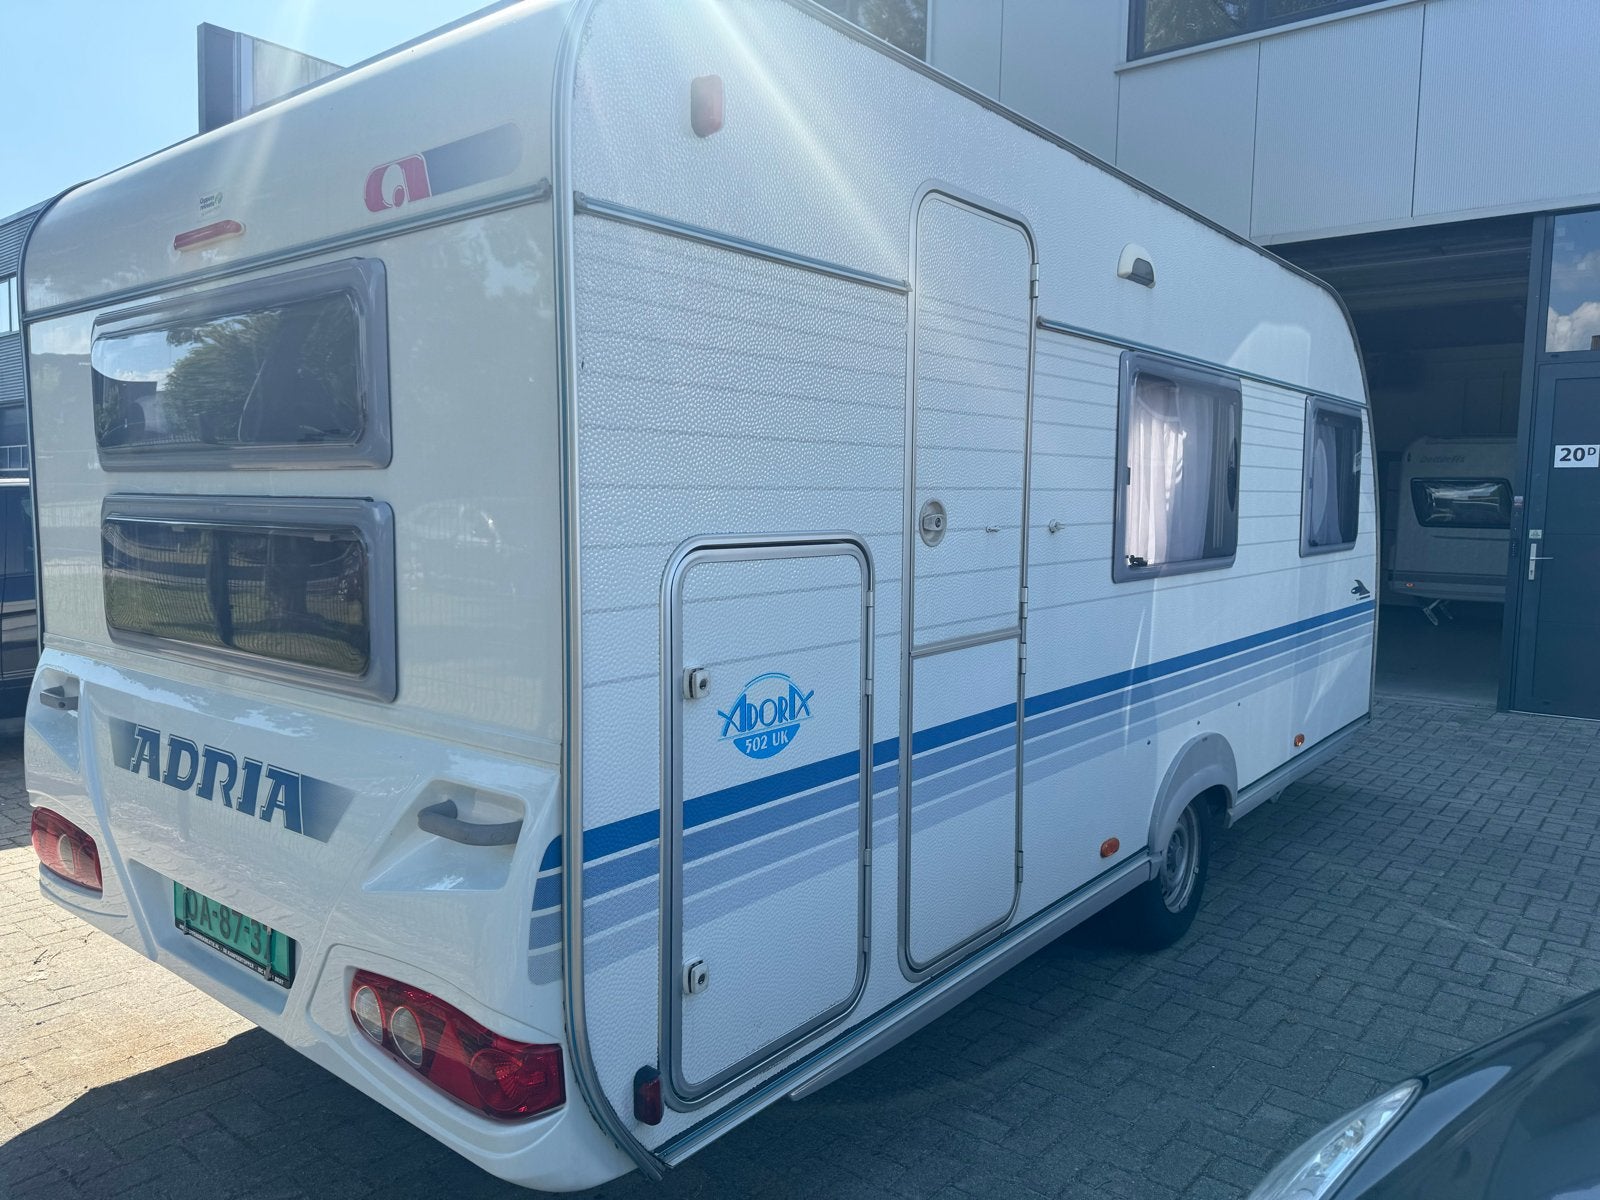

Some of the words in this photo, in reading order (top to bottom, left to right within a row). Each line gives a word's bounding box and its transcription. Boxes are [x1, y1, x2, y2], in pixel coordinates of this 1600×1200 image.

[745, 734, 768, 754] 502
[772, 729, 789, 747] UK
[129, 724, 304, 835] ADRIA
